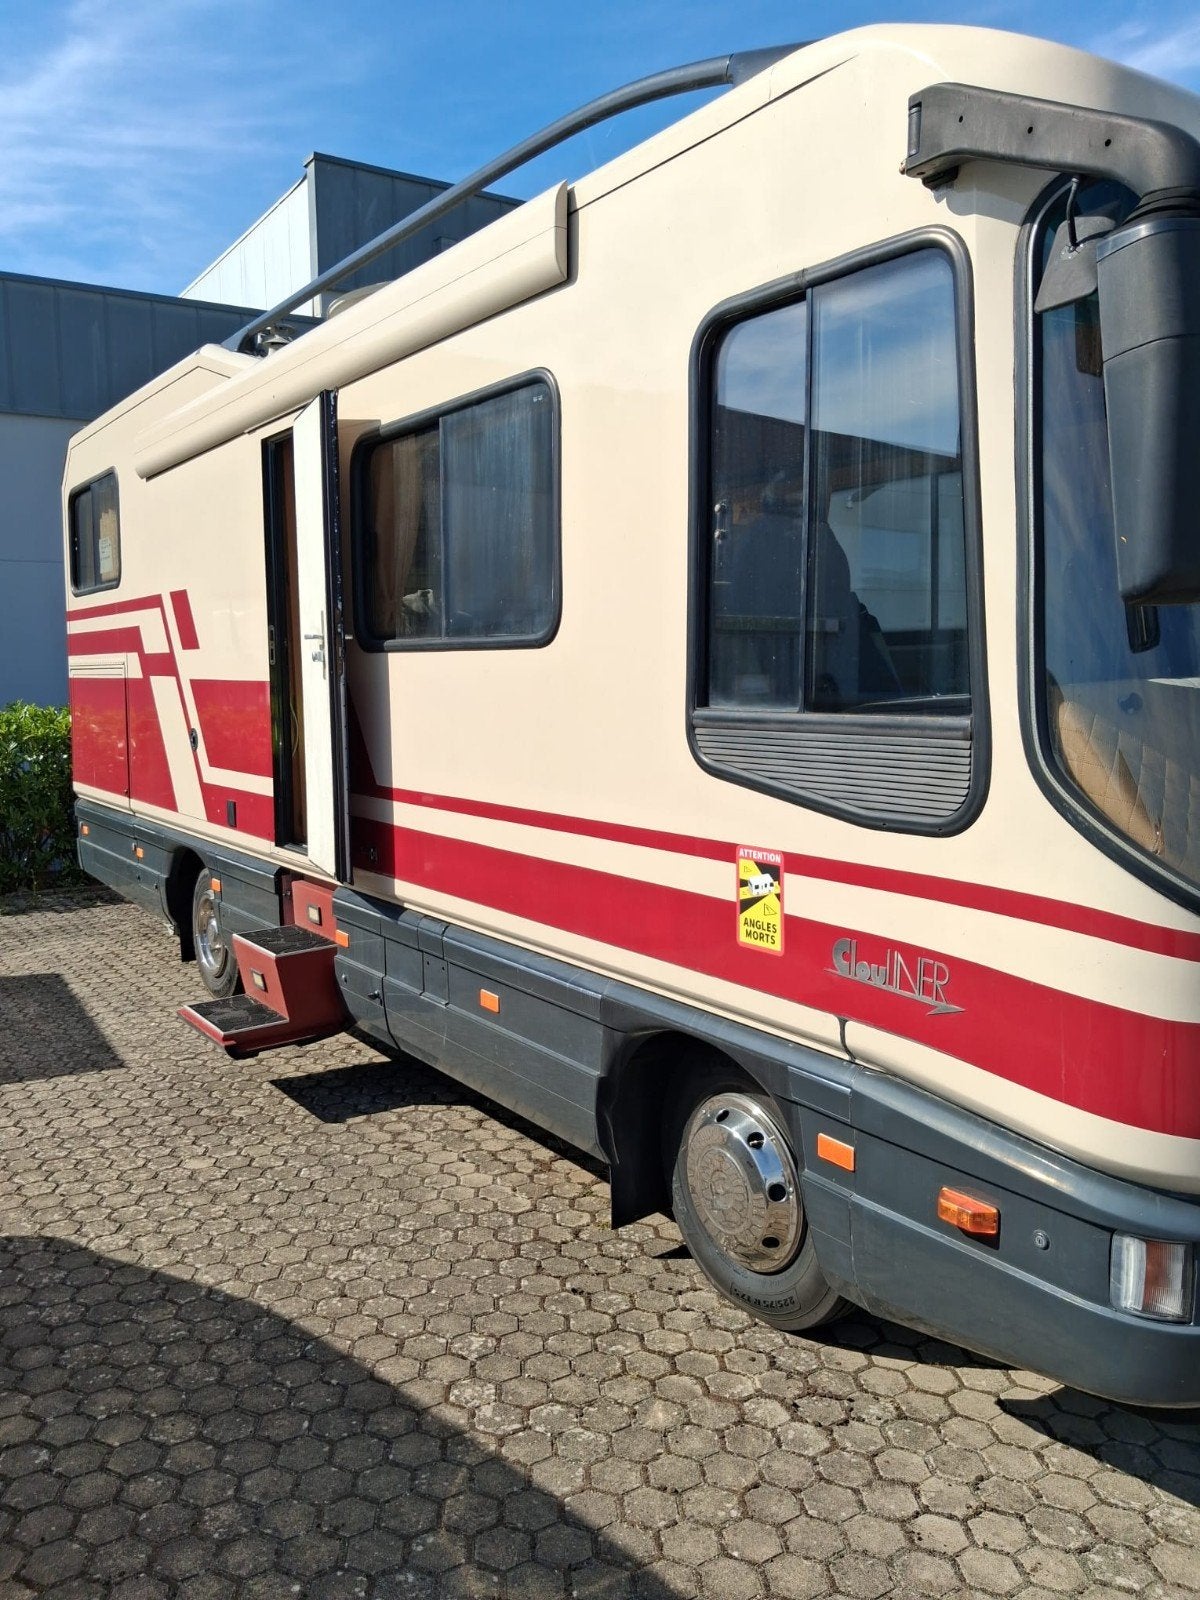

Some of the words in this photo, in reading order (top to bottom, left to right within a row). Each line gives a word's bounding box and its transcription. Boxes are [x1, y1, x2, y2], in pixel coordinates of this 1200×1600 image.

[739, 848, 781, 863] ATTENTION
[743, 917, 777, 934] ANGLES
[745, 929, 776, 945] MORTS
